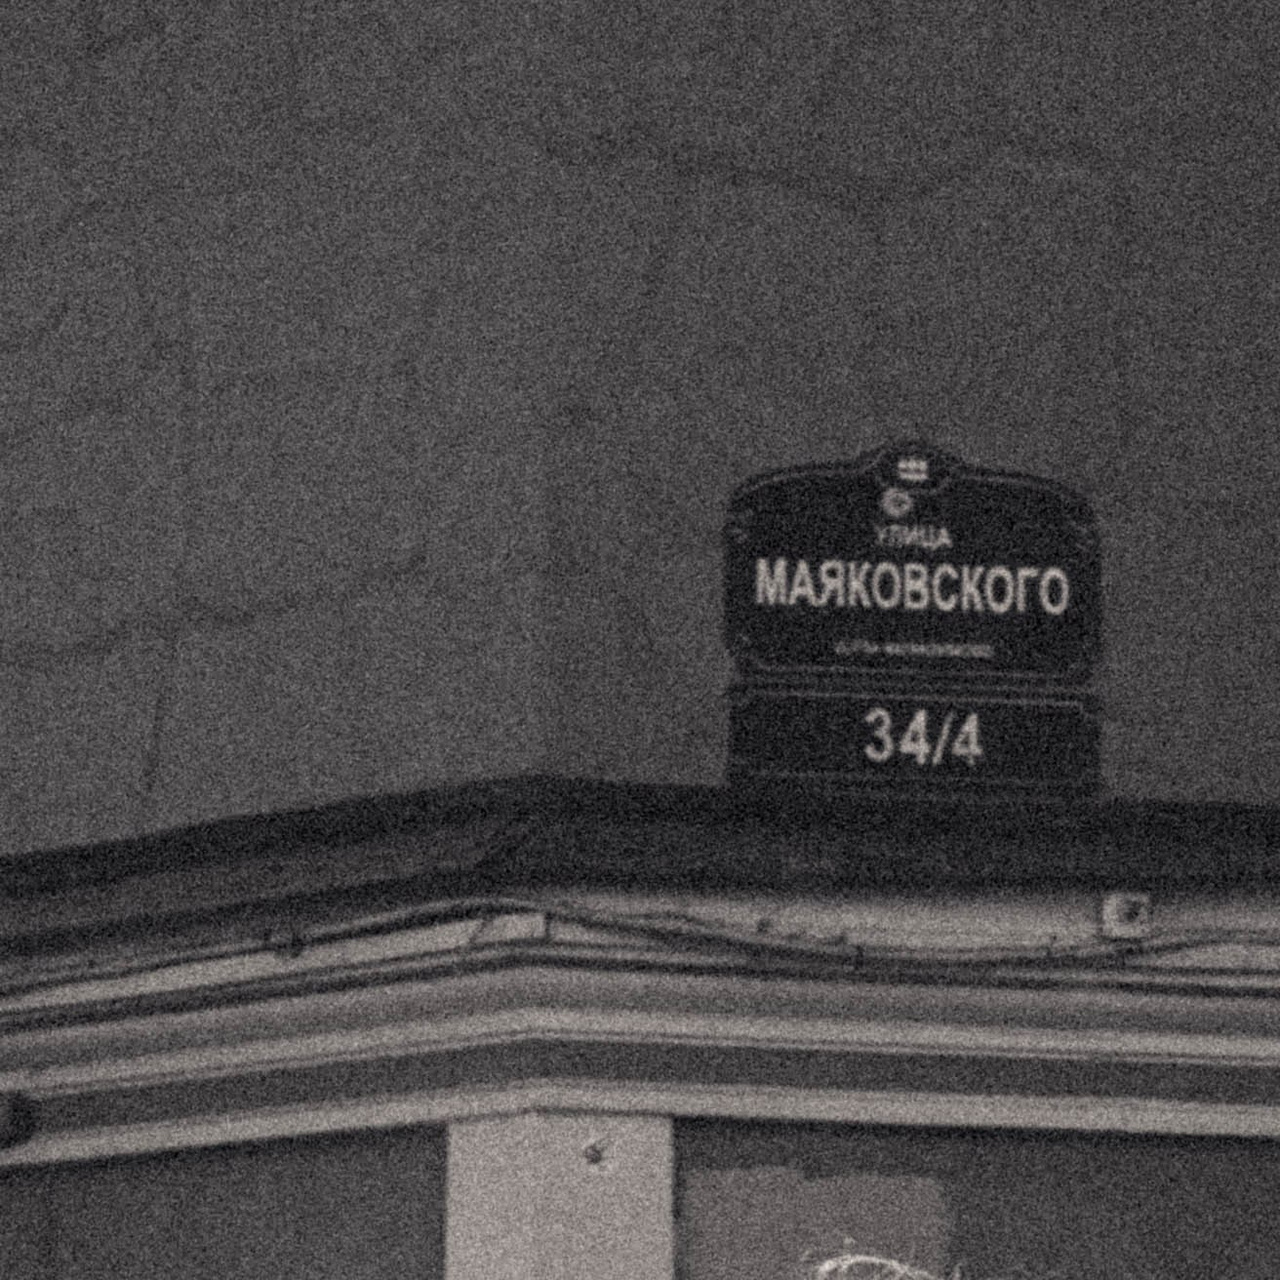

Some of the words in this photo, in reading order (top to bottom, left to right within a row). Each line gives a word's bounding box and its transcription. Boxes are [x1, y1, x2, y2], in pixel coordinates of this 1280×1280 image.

[875, 524, 953, 551] УЛИЦА
[755, 557, 1070, 615] МАЯКОВСКОГО
[862, 706, 982, 767] 34/4
